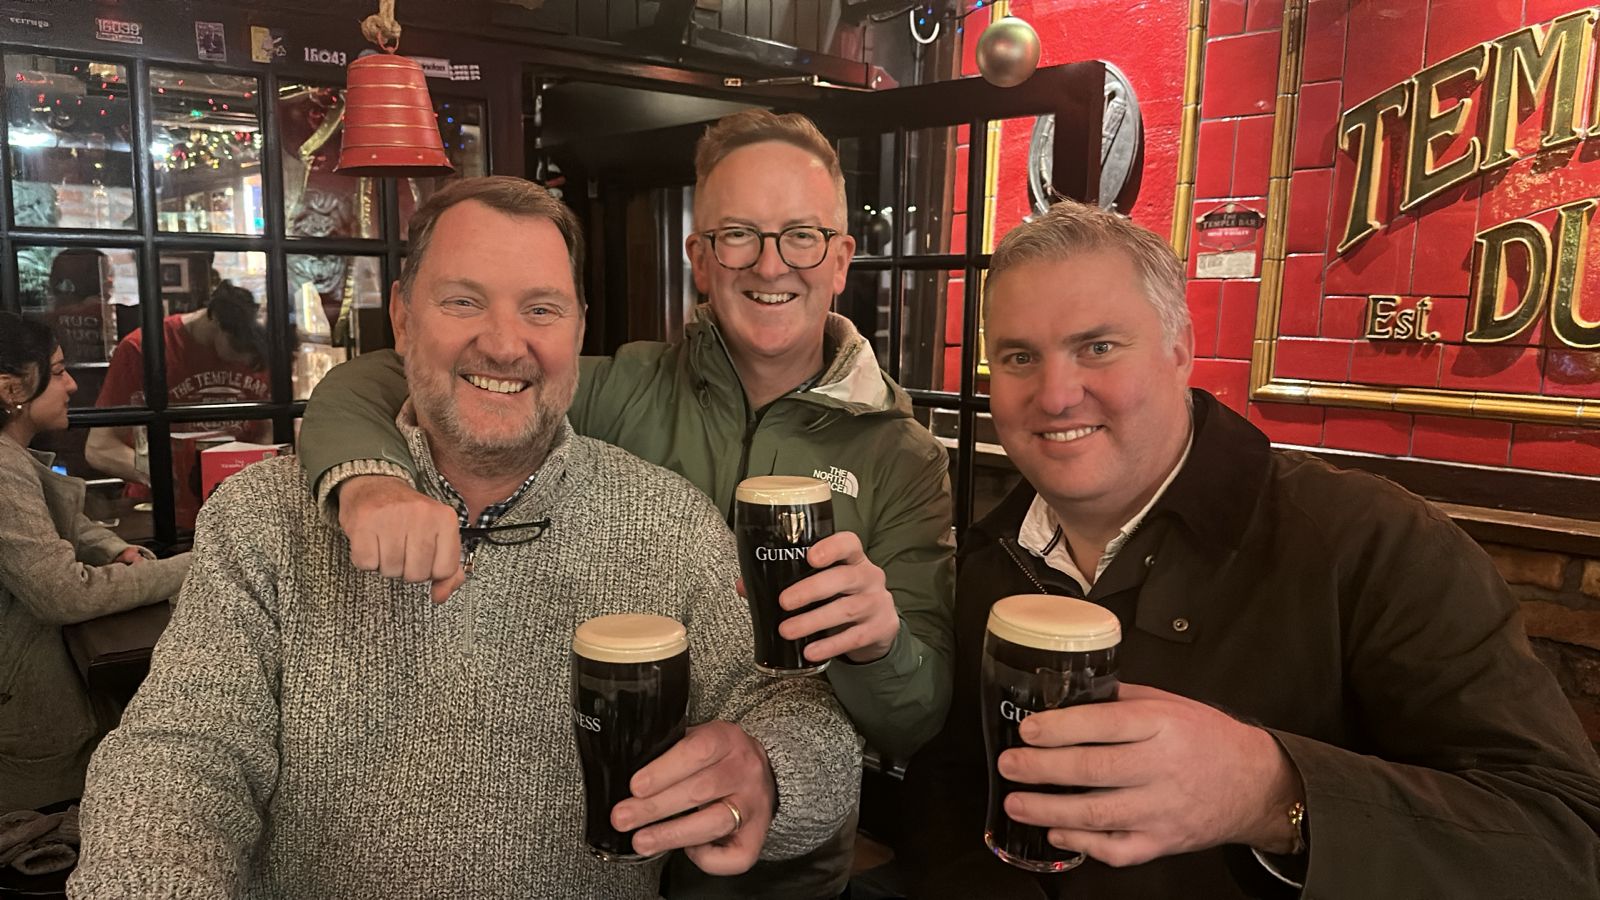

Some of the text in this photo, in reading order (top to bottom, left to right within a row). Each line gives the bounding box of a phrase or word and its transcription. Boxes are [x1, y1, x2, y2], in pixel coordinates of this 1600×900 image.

[1337, 6, 1600, 254] TEM
[1366, 294, 1441, 341] Est.
[171, 370, 269, 400] THE TEMPLE BAR
[812, 469, 846, 486] NORTH
[829, 465, 848, 478] THE
[828, 481, 844, 493] CE
[755, 546, 811, 562] GUINN
[572, 708, 601, 732] NESS
